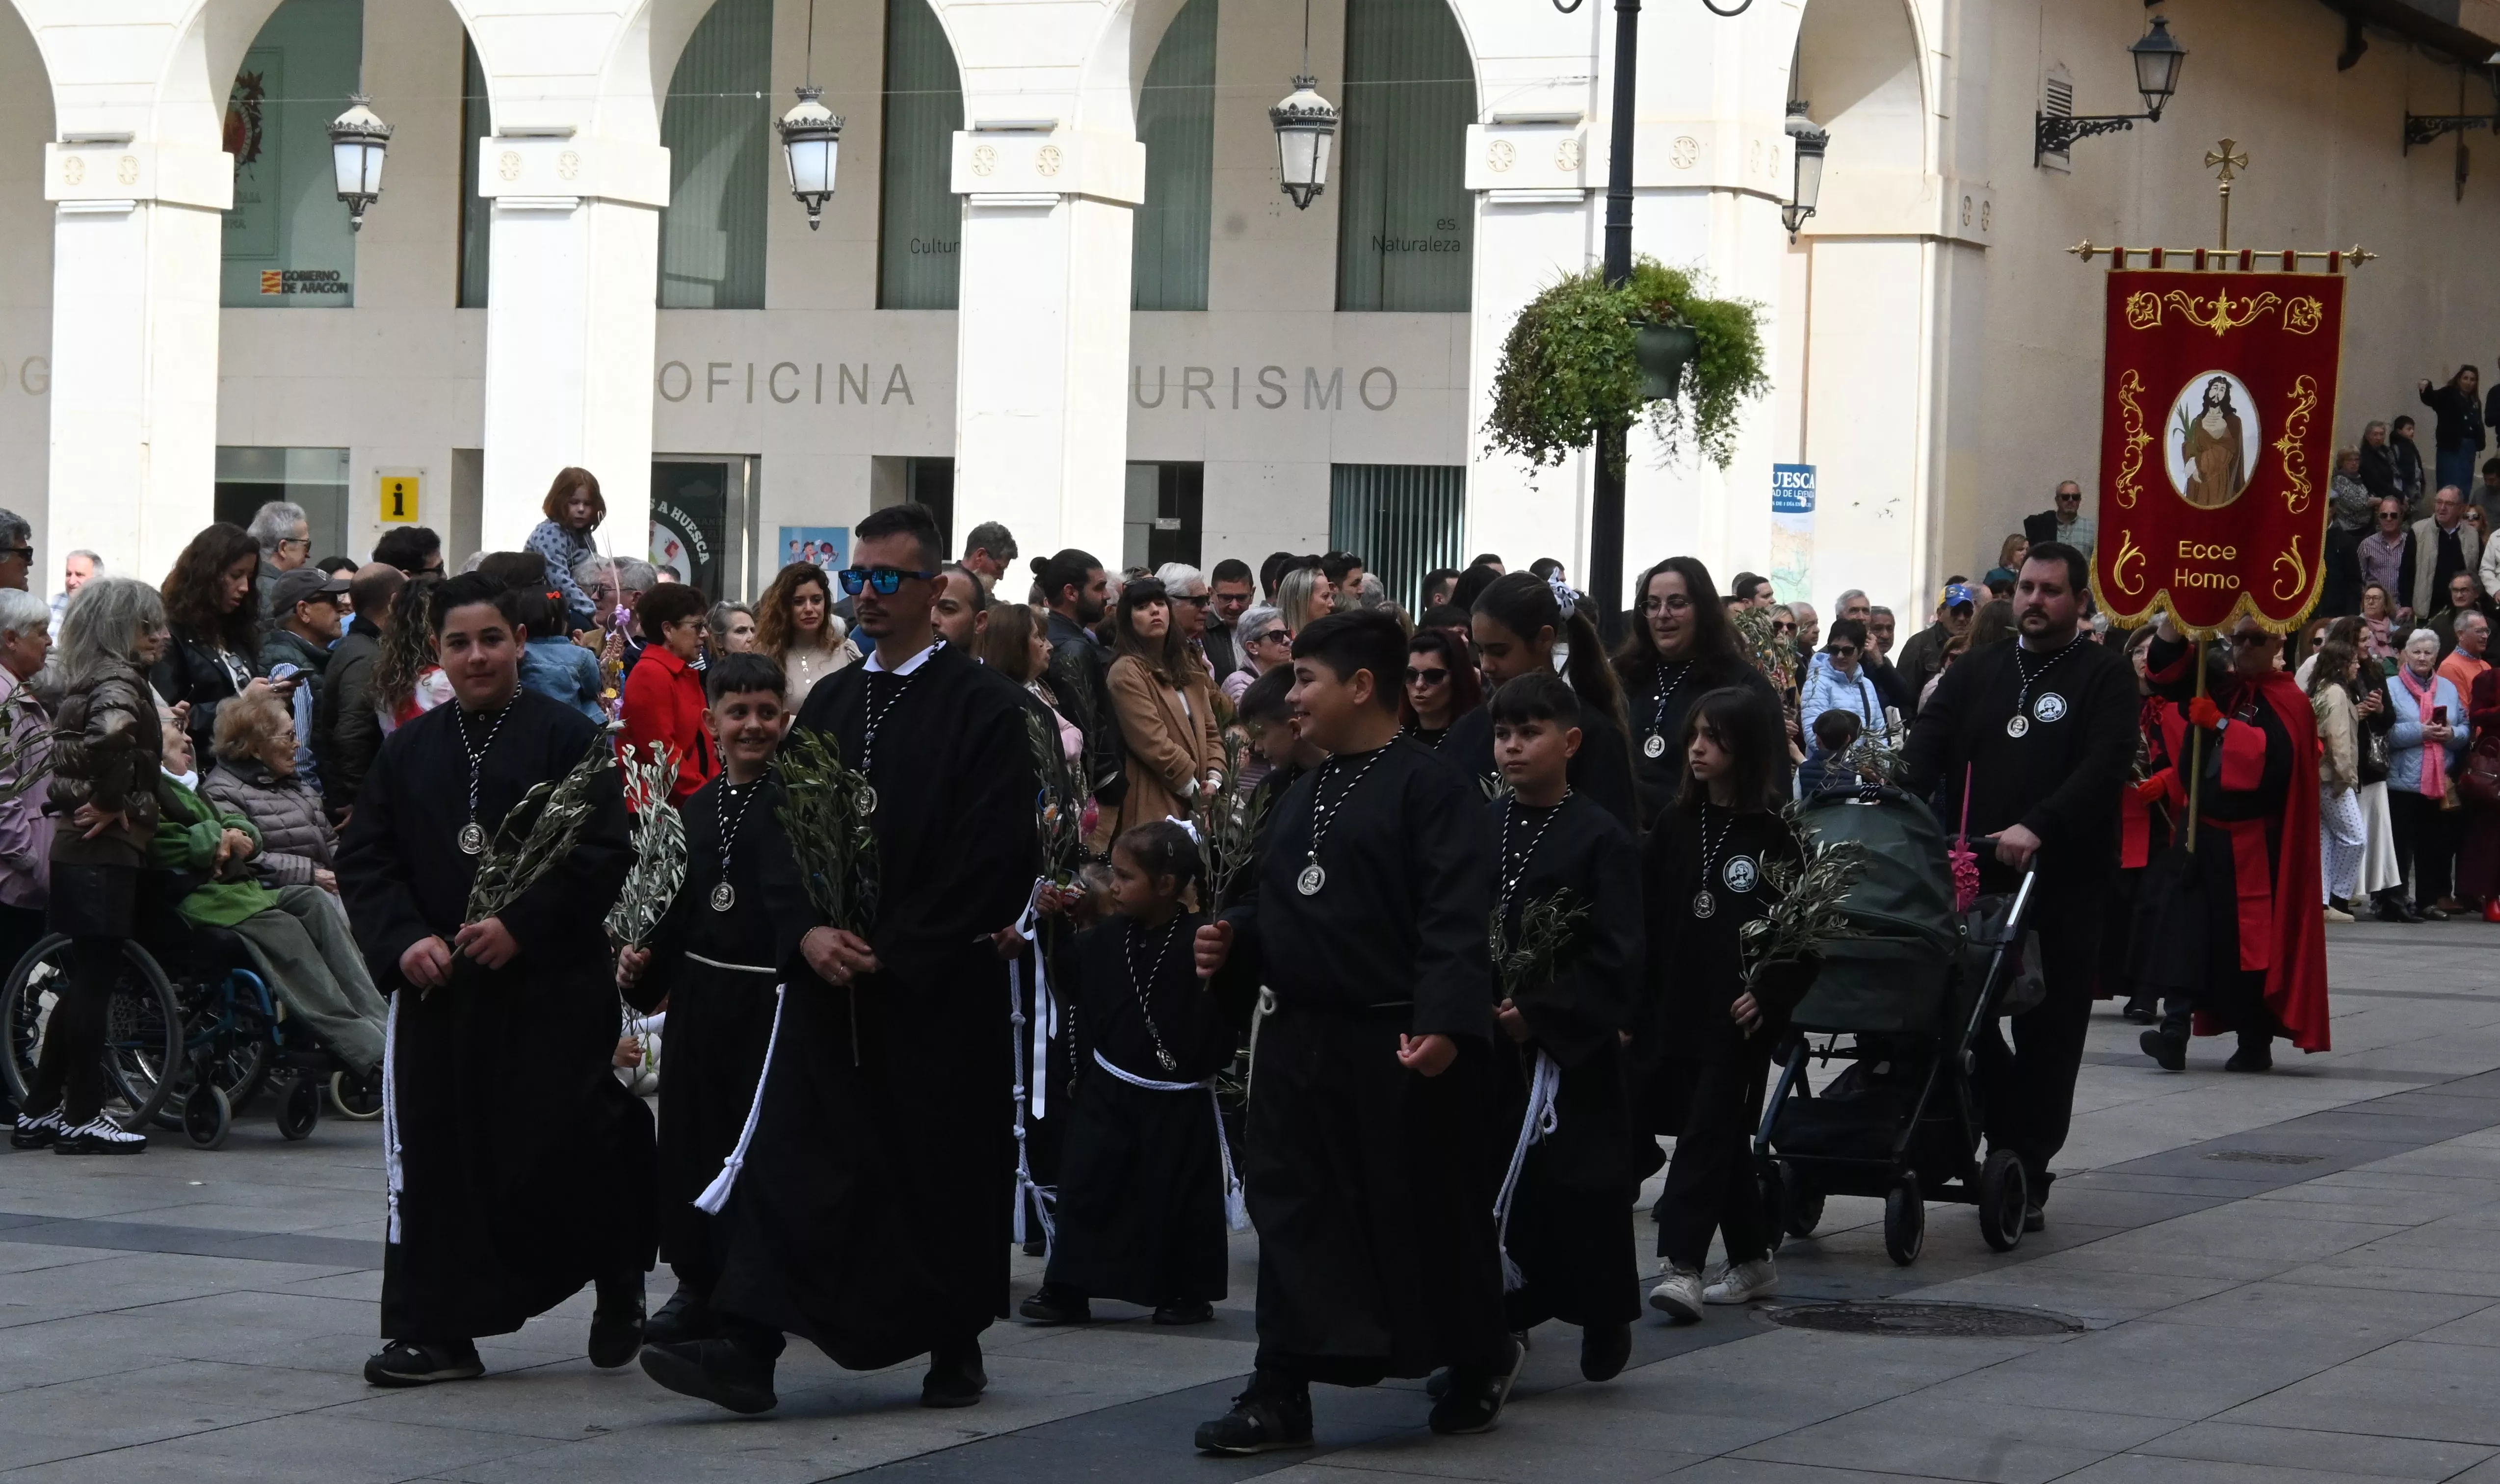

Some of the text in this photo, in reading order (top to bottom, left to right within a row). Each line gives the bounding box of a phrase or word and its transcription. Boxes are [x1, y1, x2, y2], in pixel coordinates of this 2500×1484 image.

[1372, 235, 1460, 252] Naturaleza
[282, 270, 341, 282] GOBIERNO
[282, 283, 296, 293] DE
[658, 361, 915, 405] OFICINA
[670, 506, 710, 565] HUESCA
[2179, 540, 2237, 560] Ecce
[2175, 568, 2240, 589] Homo
